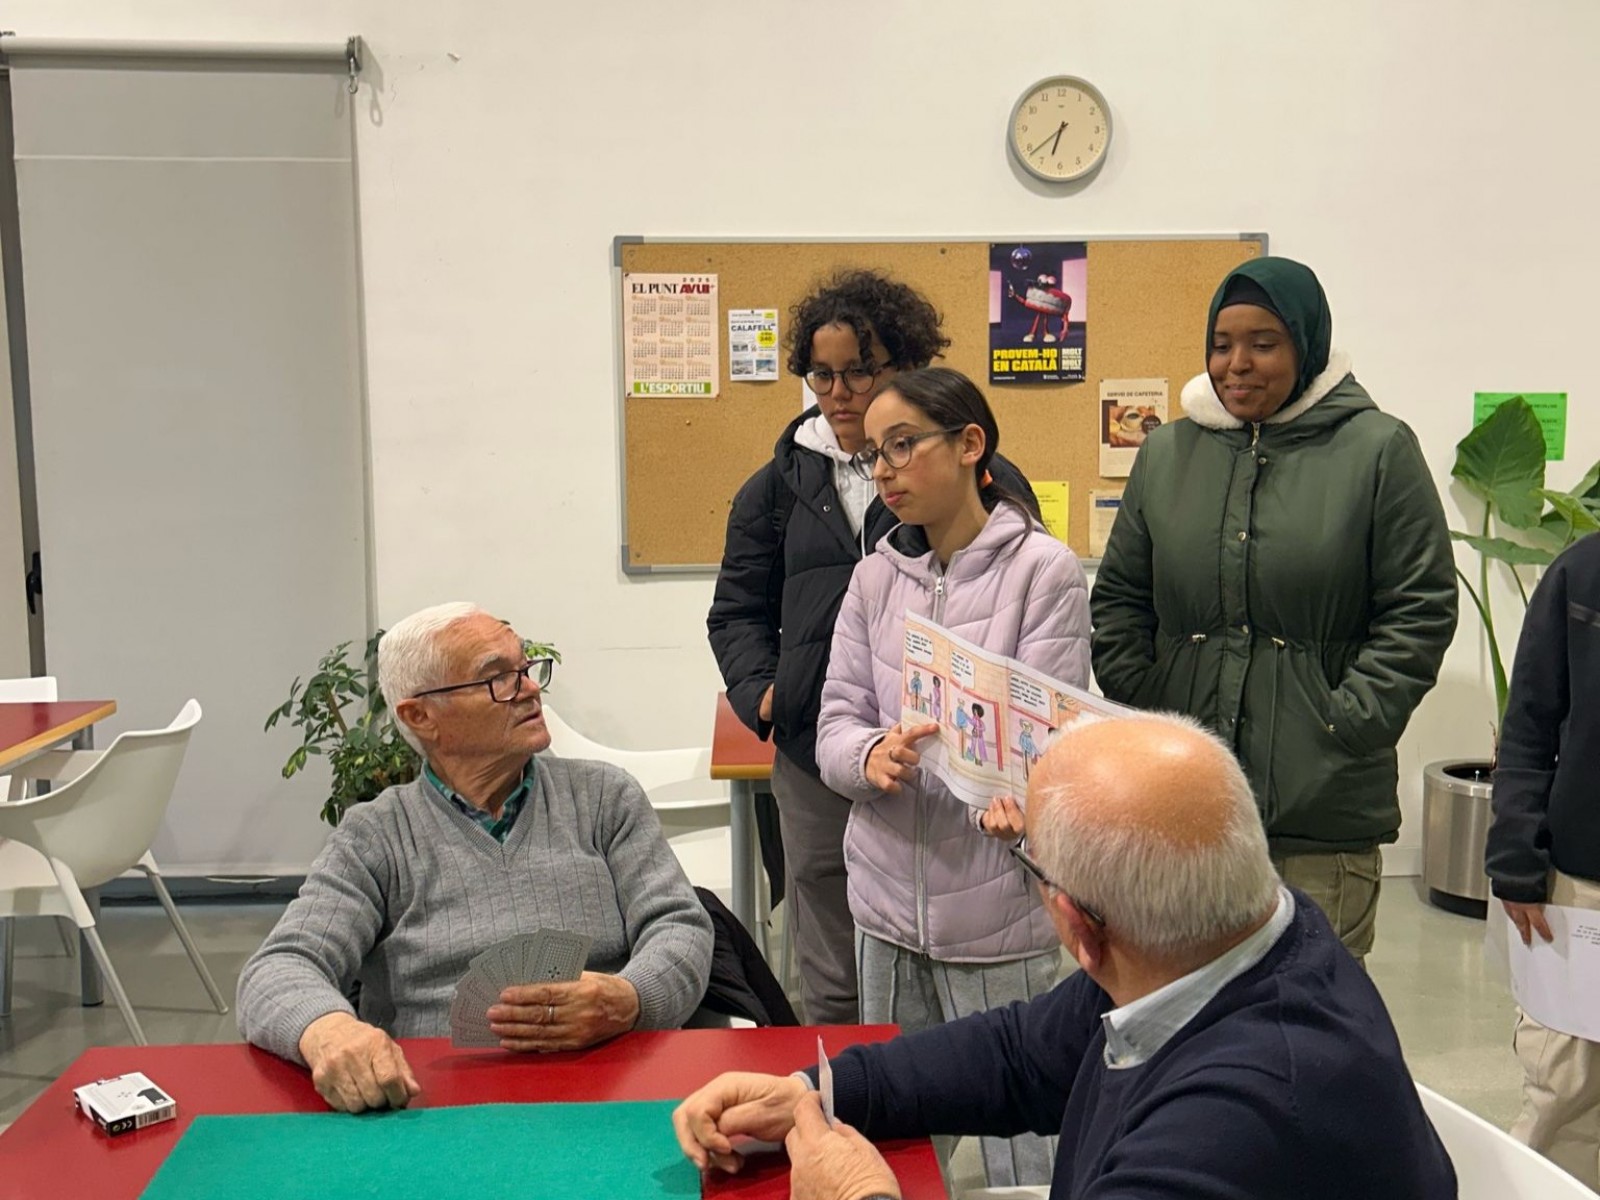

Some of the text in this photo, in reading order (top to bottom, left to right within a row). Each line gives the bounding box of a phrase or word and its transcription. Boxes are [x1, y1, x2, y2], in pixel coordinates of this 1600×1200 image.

[1057, 88, 1067, 97] 12
[1041, 93, 1049, 102] 11
[1028, 105, 1038, 114] 10
[1089, 106, 1095, 116] 2
[1022, 125, 1028, 133] 9
[1094, 126, 1100, 134] 3
[1027, 143, 1033, 151] 8
[1089, 144, 1094, 152] 4
[1039, 156, 1045, 165] 7
[1076, 156, 1081, 166] 5
[1057, 162, 1063, 170] 6
[632, 283, 647, 294] EL
[649, 283, 678, 294] PUNT
[993, 360, 1009, 372] EN
[641, 383, 705, 394] L'ESPORTIU
